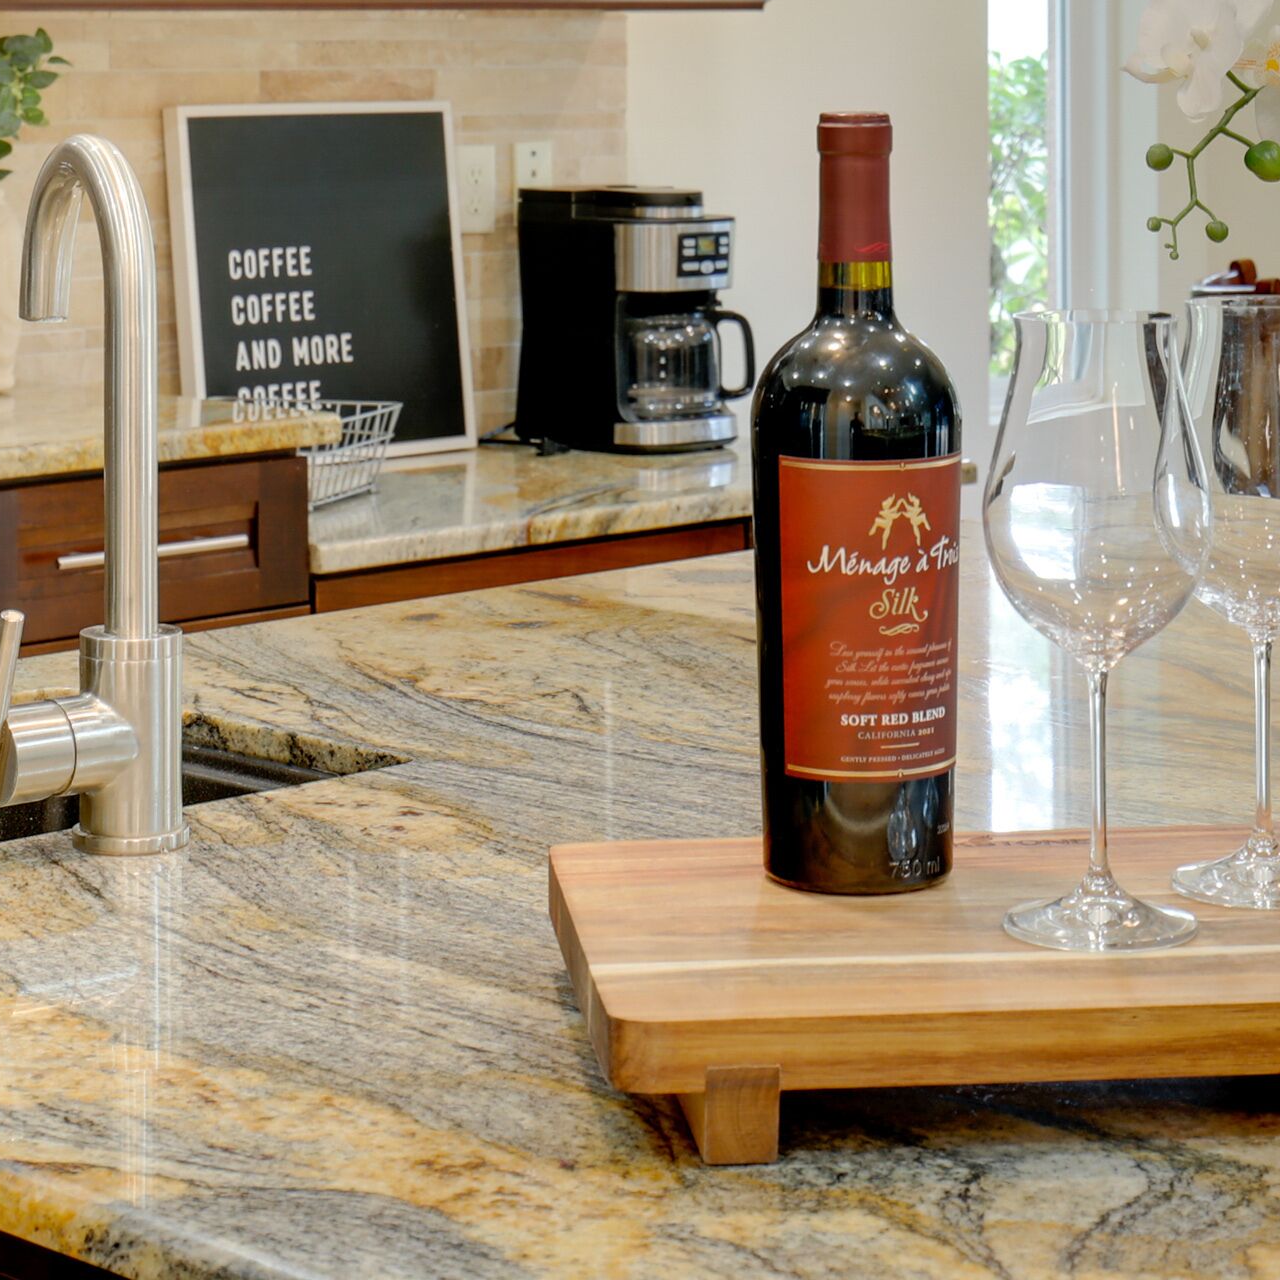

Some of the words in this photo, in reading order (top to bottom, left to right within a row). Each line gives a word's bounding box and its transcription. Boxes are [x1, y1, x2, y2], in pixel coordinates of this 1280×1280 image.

[228, 246, 313, 280] COFFEE
[231, 290, 316, 326] COFFEE
[236, 338, 283, 371] AND
[292, 332, 354, 367] MORE
[807, 544, 911, 586] Ménage
[916, 549, 930, 573] à
[869, 586, 928, 622] Silk
[840, 713, 878, 727] SOFT
[881, 712, 909, 726] RED
[912, 705, 946, 724] BLEND
[857, 729, 916, 740] CALIFORNIA
